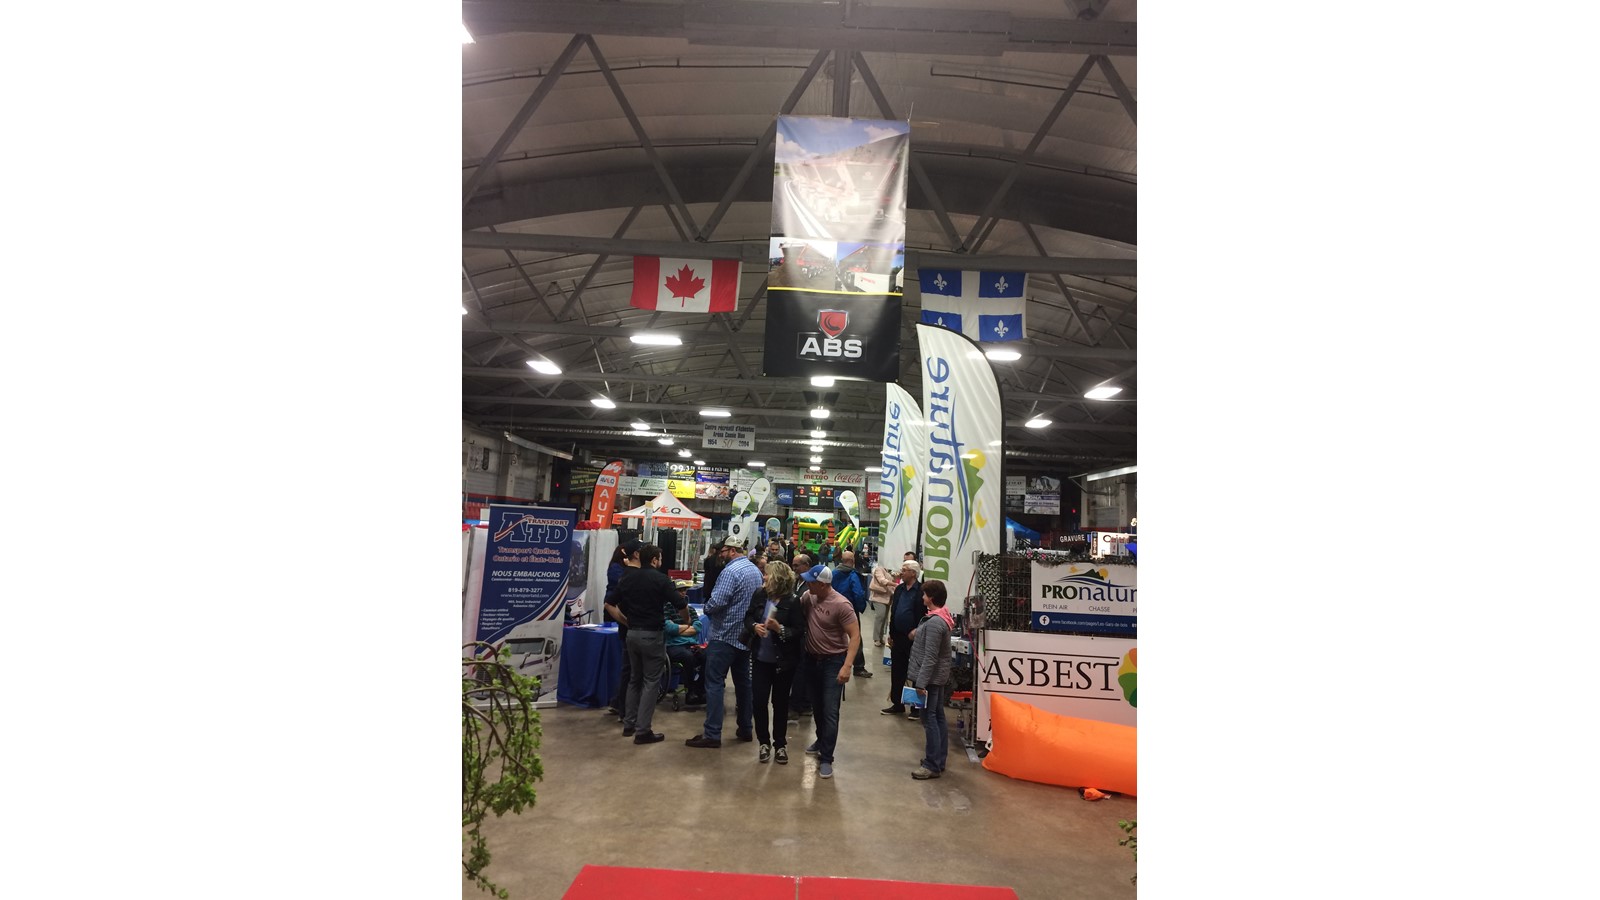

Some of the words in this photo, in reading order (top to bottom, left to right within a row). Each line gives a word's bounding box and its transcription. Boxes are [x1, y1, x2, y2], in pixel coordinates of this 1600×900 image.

[800, 338, 863, 359] ABS
[526, 518, 569, 526] TRANSPORT
[494, 512, 568, 544] ATD
[1060, 534, 1085, 542] GRAVURE
[529, 555, 563, 564] États-Unis
